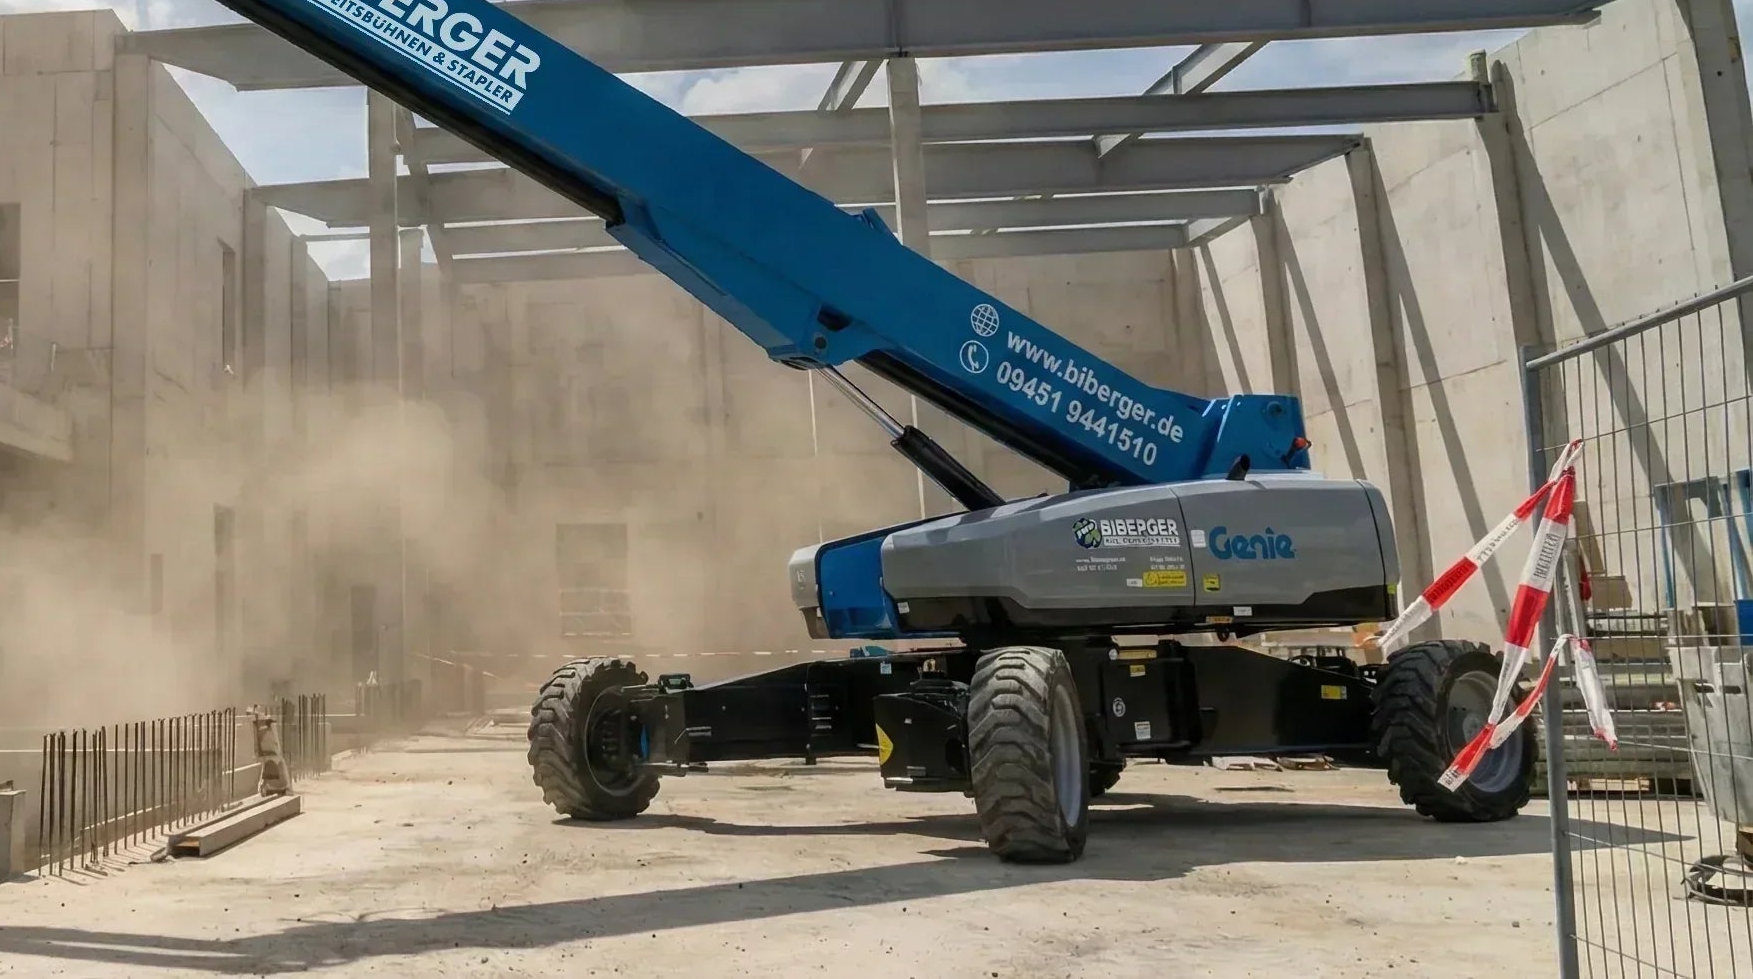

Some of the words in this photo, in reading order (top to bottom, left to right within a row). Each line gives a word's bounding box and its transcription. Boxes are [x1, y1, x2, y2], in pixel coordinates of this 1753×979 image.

[432, 51, 446, 66] &
[446, 60, 514, 105] STAPLER
[996, 361, 1063, 413] 09451
[1065, 399, 1158, 466] 9441510
[1007, 331, 1184, 443] www.biberger.de
[1209, 525, 1295, 560] Genie
